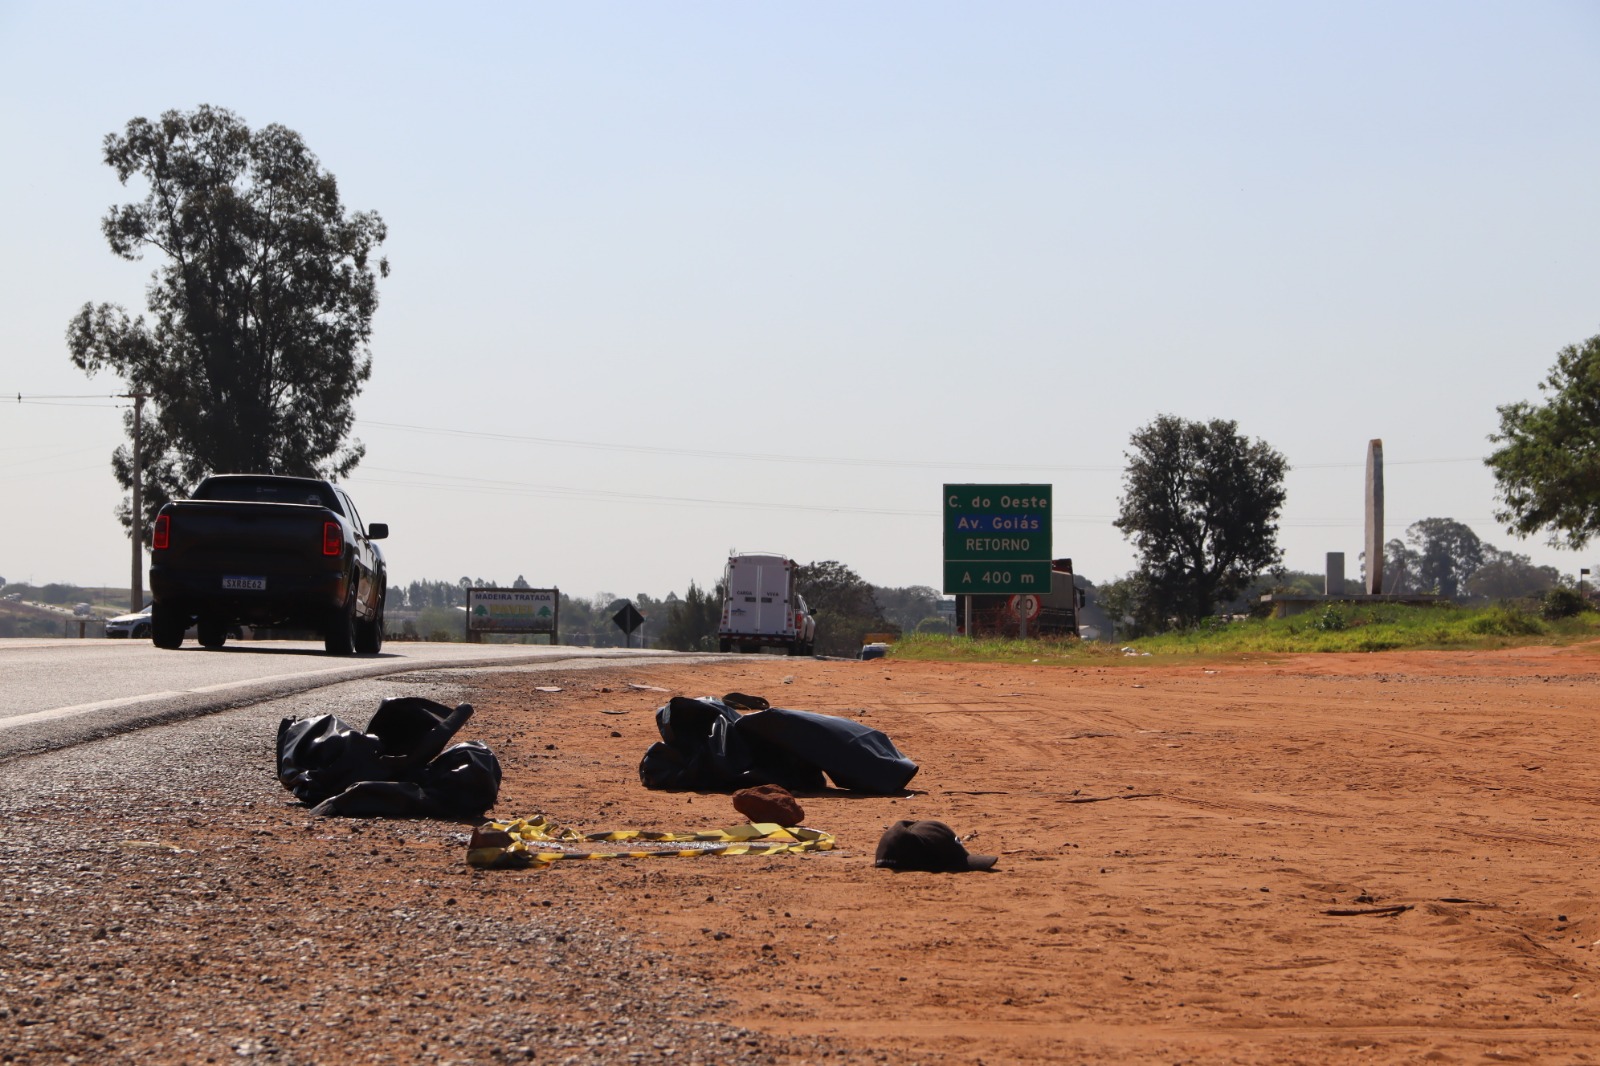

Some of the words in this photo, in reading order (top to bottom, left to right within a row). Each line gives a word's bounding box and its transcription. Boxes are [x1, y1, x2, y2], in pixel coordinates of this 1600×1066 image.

[948, 495, 962, 508] C.
[971, 496, 991, 508] do
[1000, 495, 1047, 508] Oeste
[957, 517, 983, 529] Av.
[992, 515, 1039, 529] Goiás
[966, 538, 1030, 551] RETORNO
[962, 571, 972, 584] A
[982, 571, 1011, 584] 400
[1020, 573, 1035, 584] m
